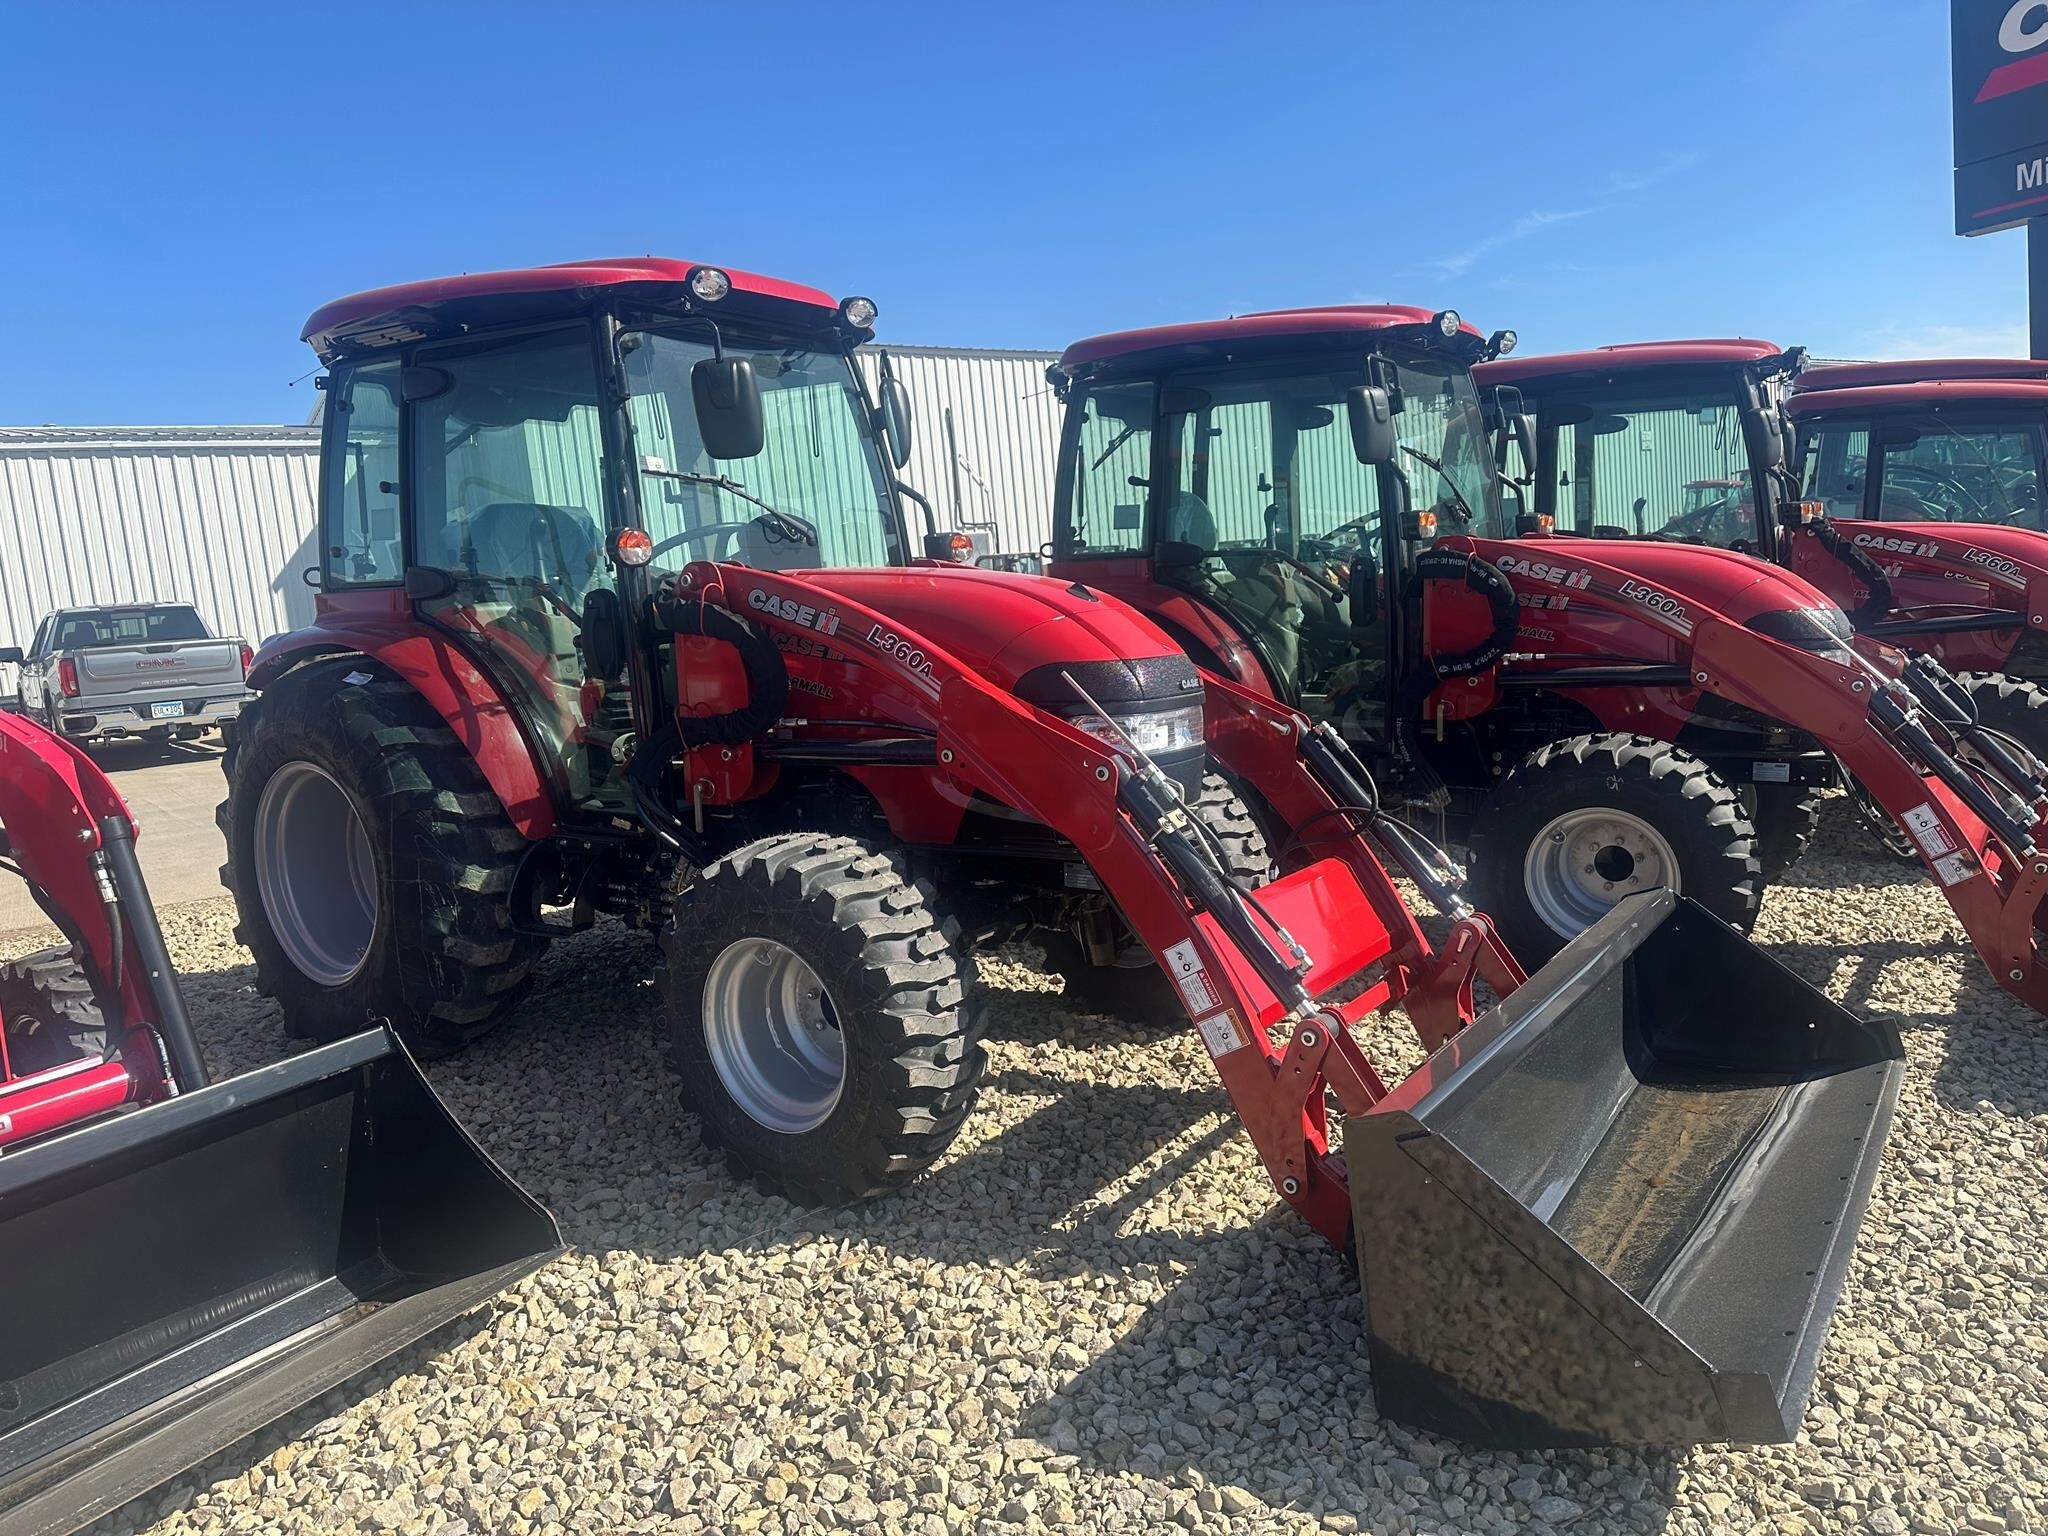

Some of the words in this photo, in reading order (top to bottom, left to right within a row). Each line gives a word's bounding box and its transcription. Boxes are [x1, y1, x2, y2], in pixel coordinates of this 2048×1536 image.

[1853, 533, 1916, 554] CASE
[1496, 555, 1567, 584] CASE
[1962, 547, 2021, 577] L360A
[748, 588, 816, 627] CASE
[1618, 579, 1687, 621] L360A
[774, 632, 825, 658] CASE
[866, 624, 935, 678] L360A
[790, 676, 833, 699] RMALL
[1181, 678, 1200, 689] CASE
[1203, 978, 1218, 1004] DANGER
